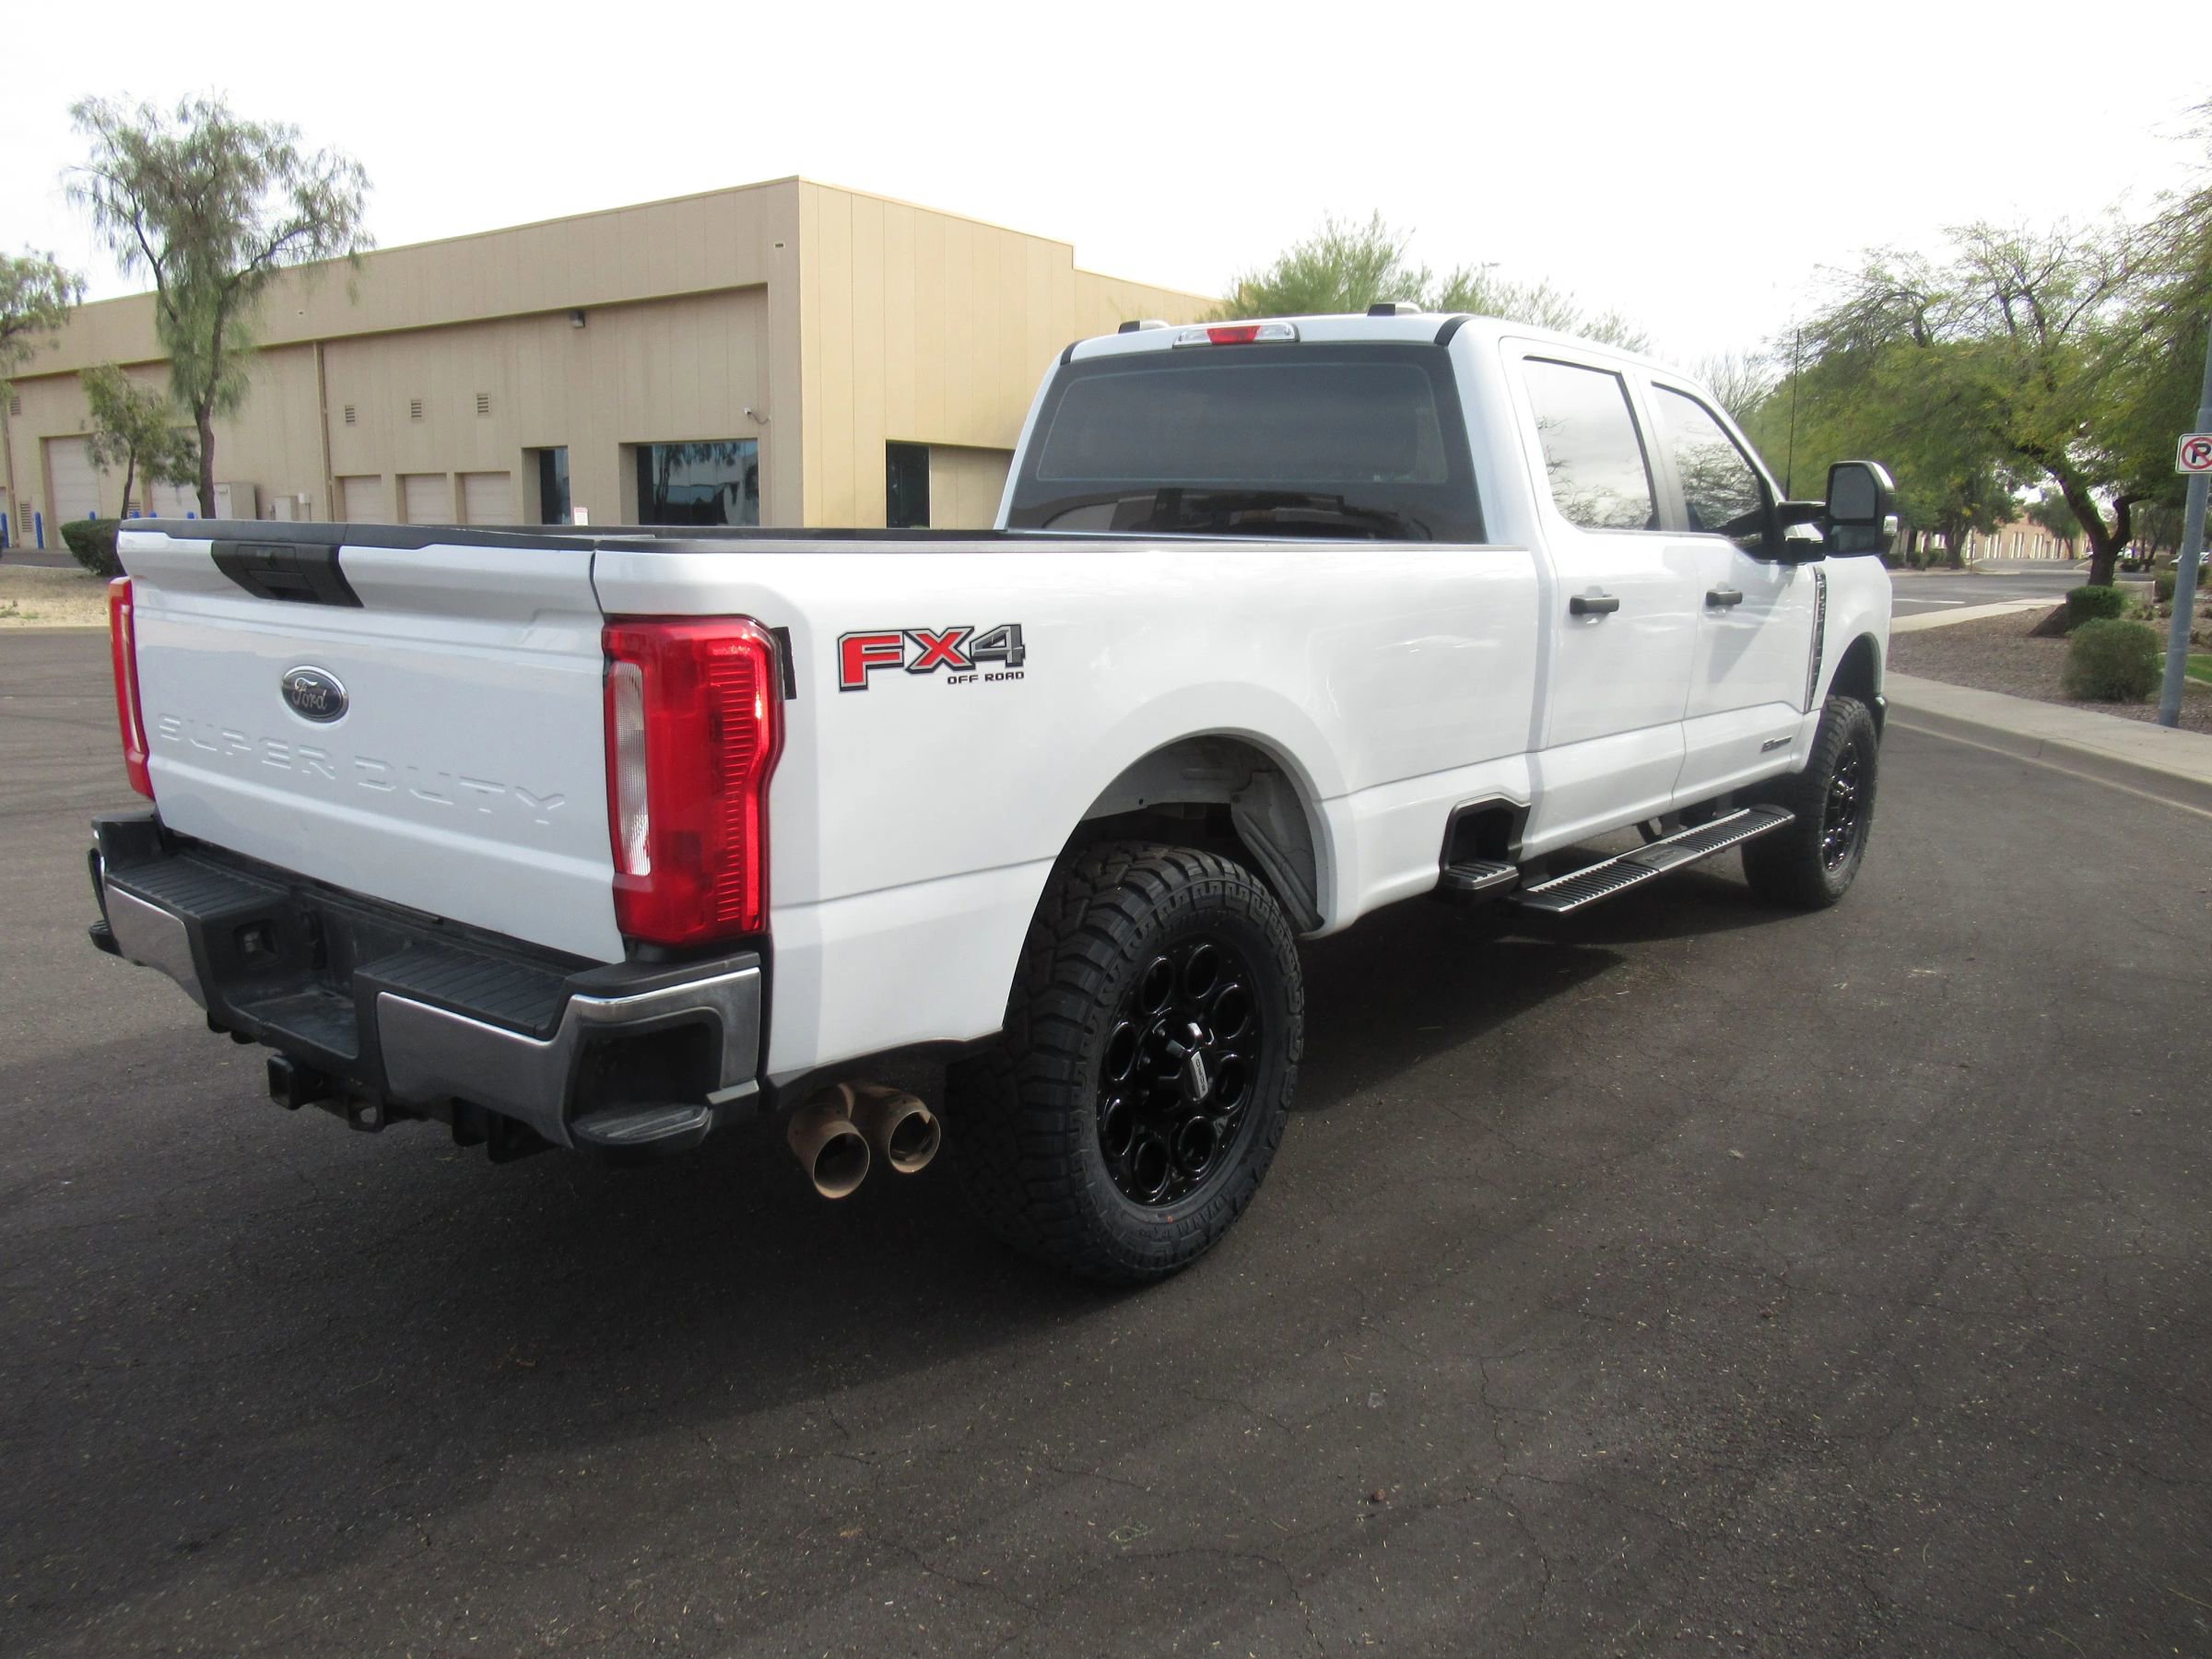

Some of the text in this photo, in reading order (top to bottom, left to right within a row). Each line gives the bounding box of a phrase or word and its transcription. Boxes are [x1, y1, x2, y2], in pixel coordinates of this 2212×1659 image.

[2191, 442, 2211, 464] P
[837, 623, 1025, 692] FX4
[291, 677, 328, 711] Ford
[947, 671, 1025, 686] OFF ROAD
[159, 713, 565, 825] SUPER DUTY
